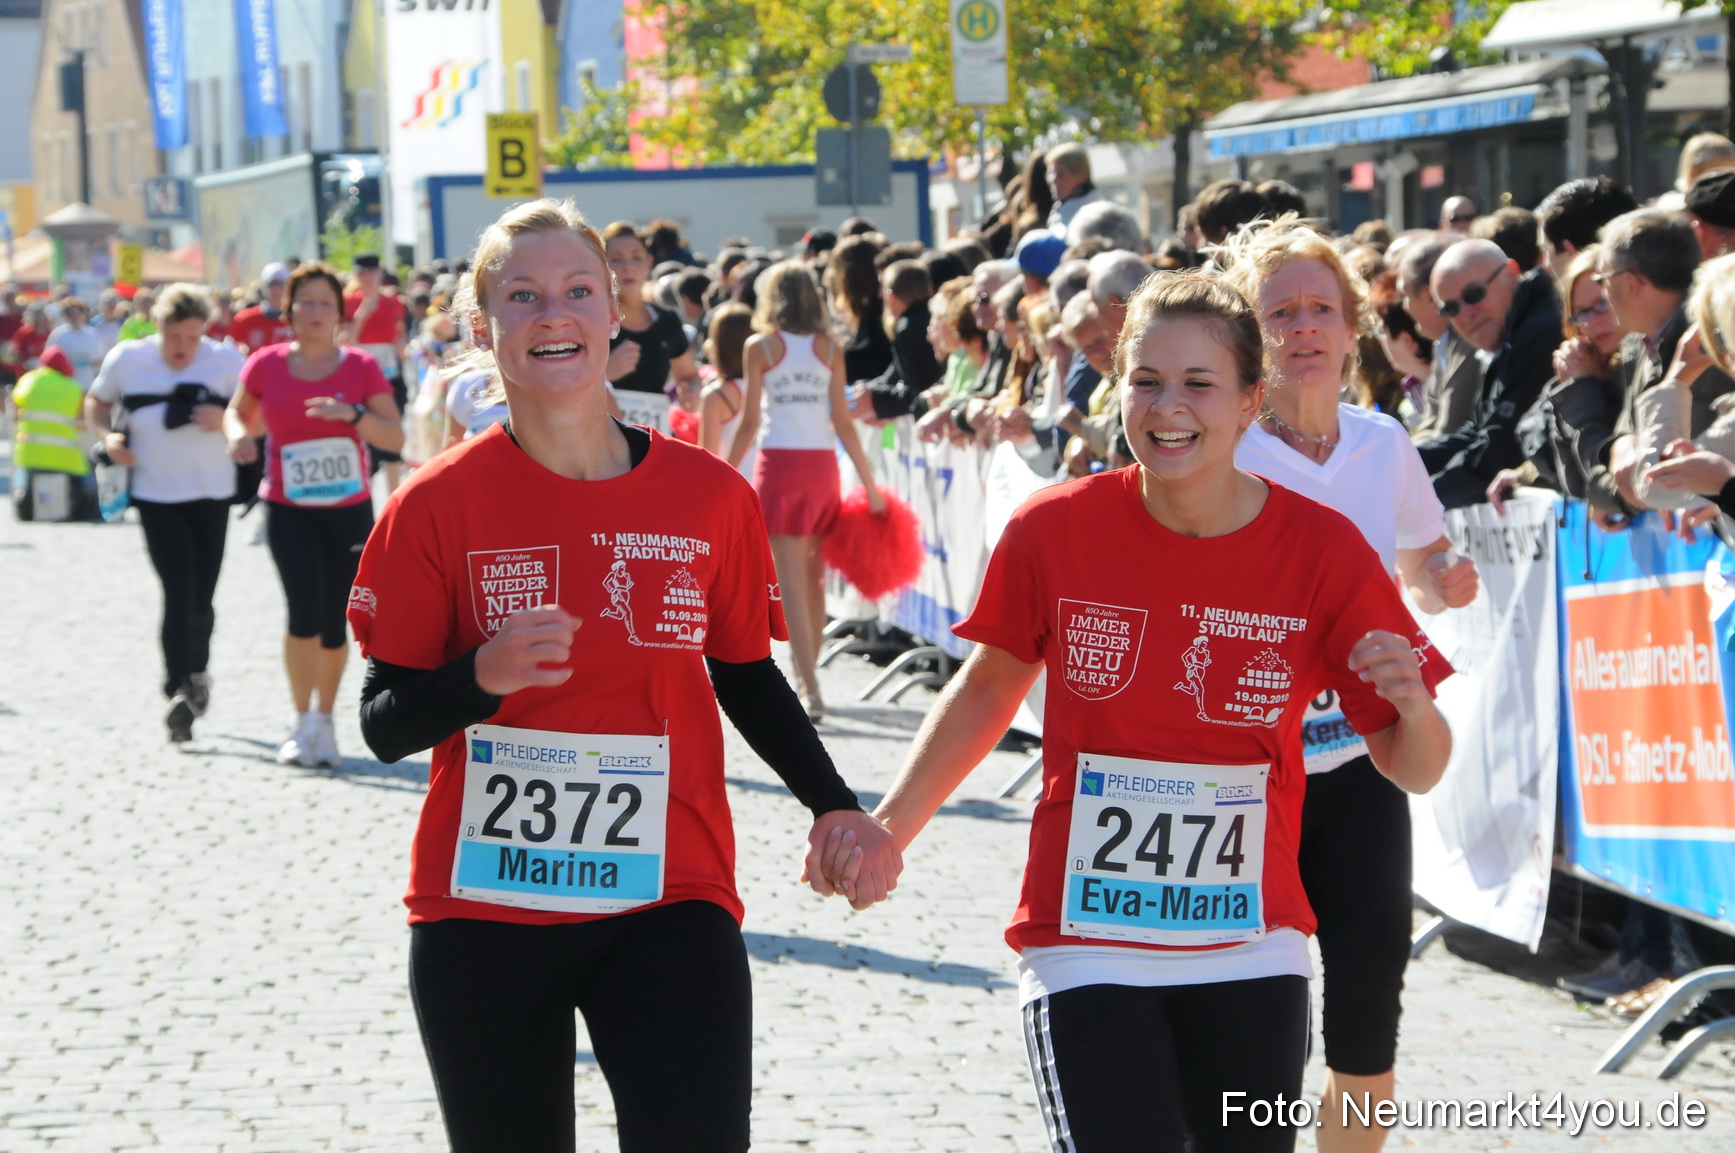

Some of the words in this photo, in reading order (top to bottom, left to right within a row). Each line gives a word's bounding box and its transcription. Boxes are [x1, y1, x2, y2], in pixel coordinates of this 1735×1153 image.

[501, 139, 526, 178] B
[291, 455, 351, 485] 3200
[591, 533, 613, 545] 11.
[616, 533, 710, 556] NEUMARKTER
[613, 546, 695, 563] STADTLAUF
[482, 561, 545, 578] IMMER
[480, 576, 548, 594] WIEDER
[485, 591, 544, 616] NEU
[1085, 607, 1099, 615] 850
[1099, 609, 1119, 618] Jahre
[1069, 614, 1130, 635] IMMER
[1181, 604, 1200, 619] 11.
[1204, 607, 1307, 632] NEUMARKTER
[1066, 629, 1131, 651] WIEDER
[1199, 621, 1287, 643] STADTLAUF
[1066, 645, 1124, 672] NEU
[1066, 667, 1120, 687] MARKT
[1234, 691, 1290, 704] 19.09.2010
[1301, 720, 1357, 746] Kers
[496, 742, 577, 764] PFLEIDERER
[598, 756, 651, 767] BOCK
[1579, 733, 1616, 786] DSL
[495, 760, 577, 774] AKTIENGESELLSCHAFT
[1108, 773, 1195, 796] PFLEIDERER
[1215, 785, 1253, 798] BOCK
[1106, 791, 1195, 806] AKTIENGESELLSCHAFT
[481, 773, 642, 847] 2372
[1091, 806, 1245, 878] 2474
[497, 846, 618, 888] Marina
[1081, 877, 1248, 921] Eva-Maria
